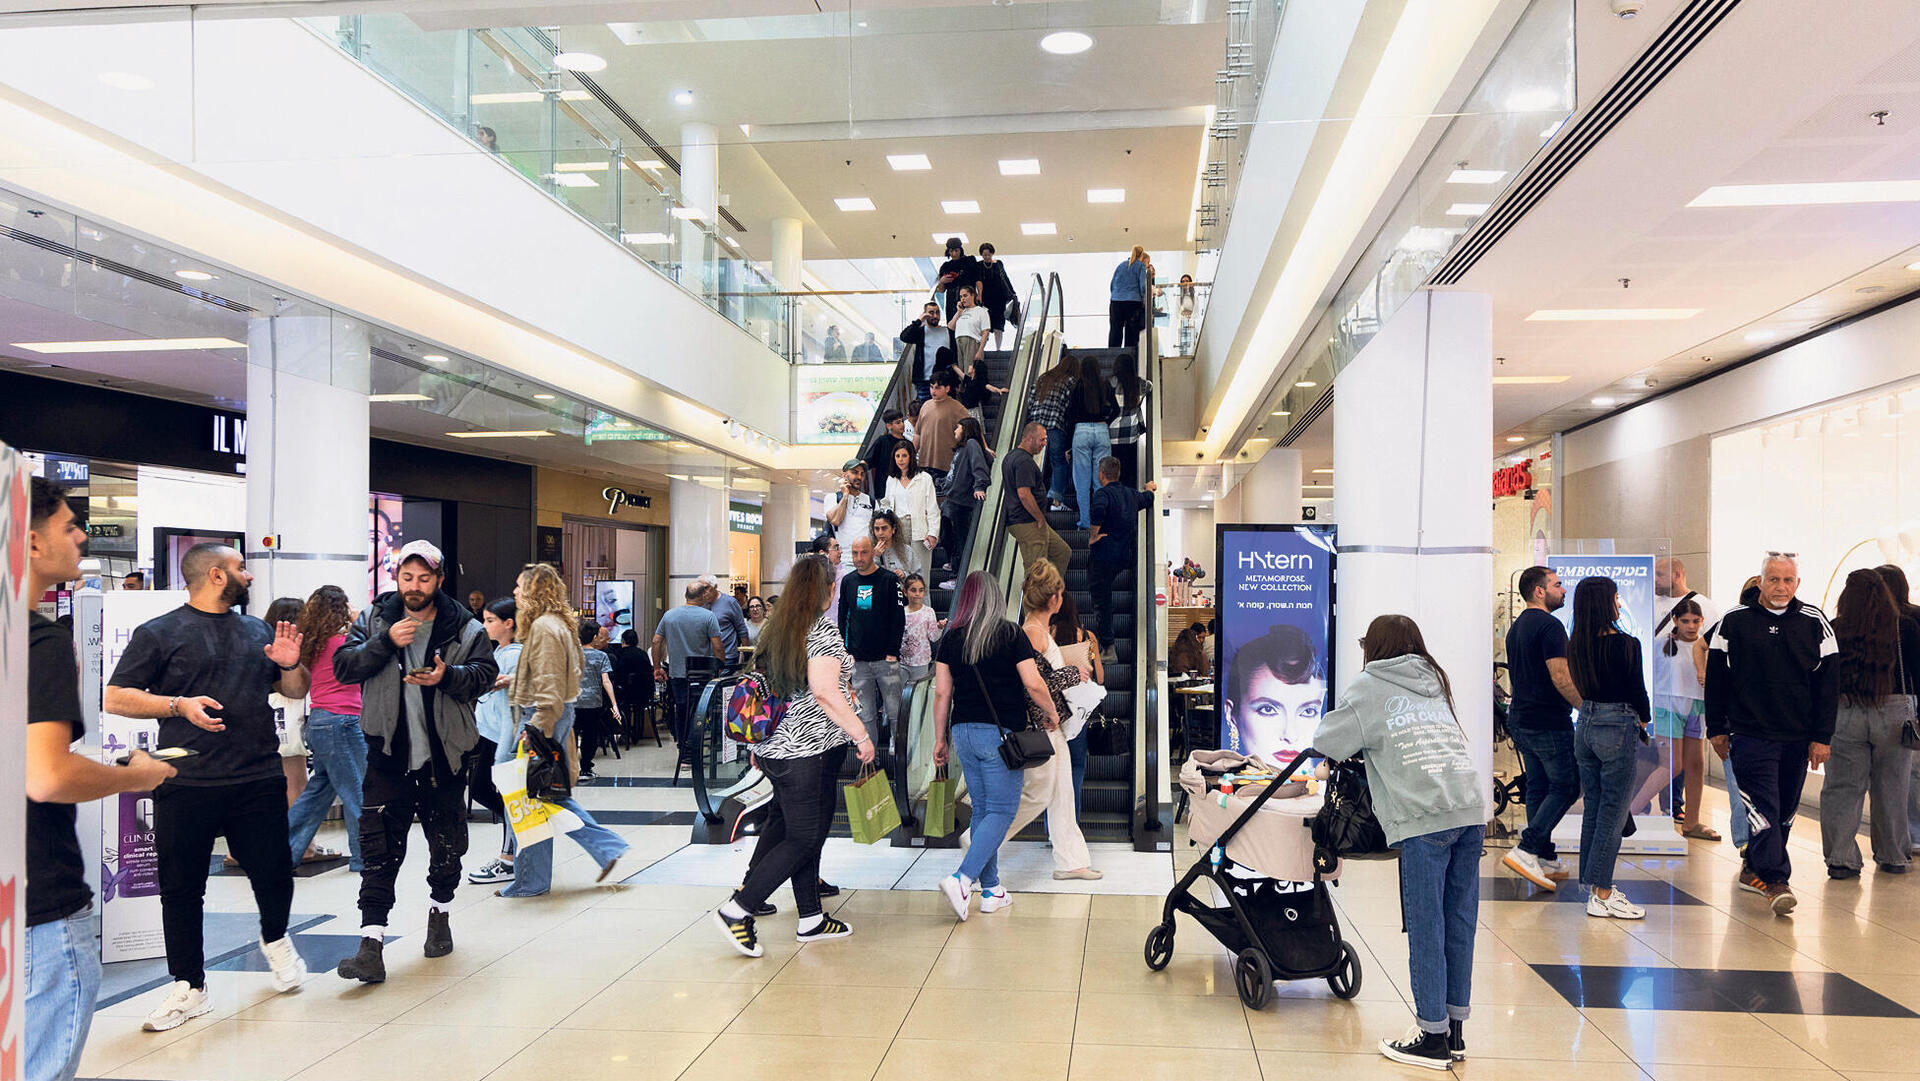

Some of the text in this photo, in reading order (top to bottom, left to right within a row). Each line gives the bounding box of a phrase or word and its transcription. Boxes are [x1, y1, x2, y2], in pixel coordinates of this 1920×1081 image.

[213, 414, 230, 453] IL
[1556, 566, 1648, 578] EMBOSS בוטיק
[1386, 712, 1418, 730] FOR
